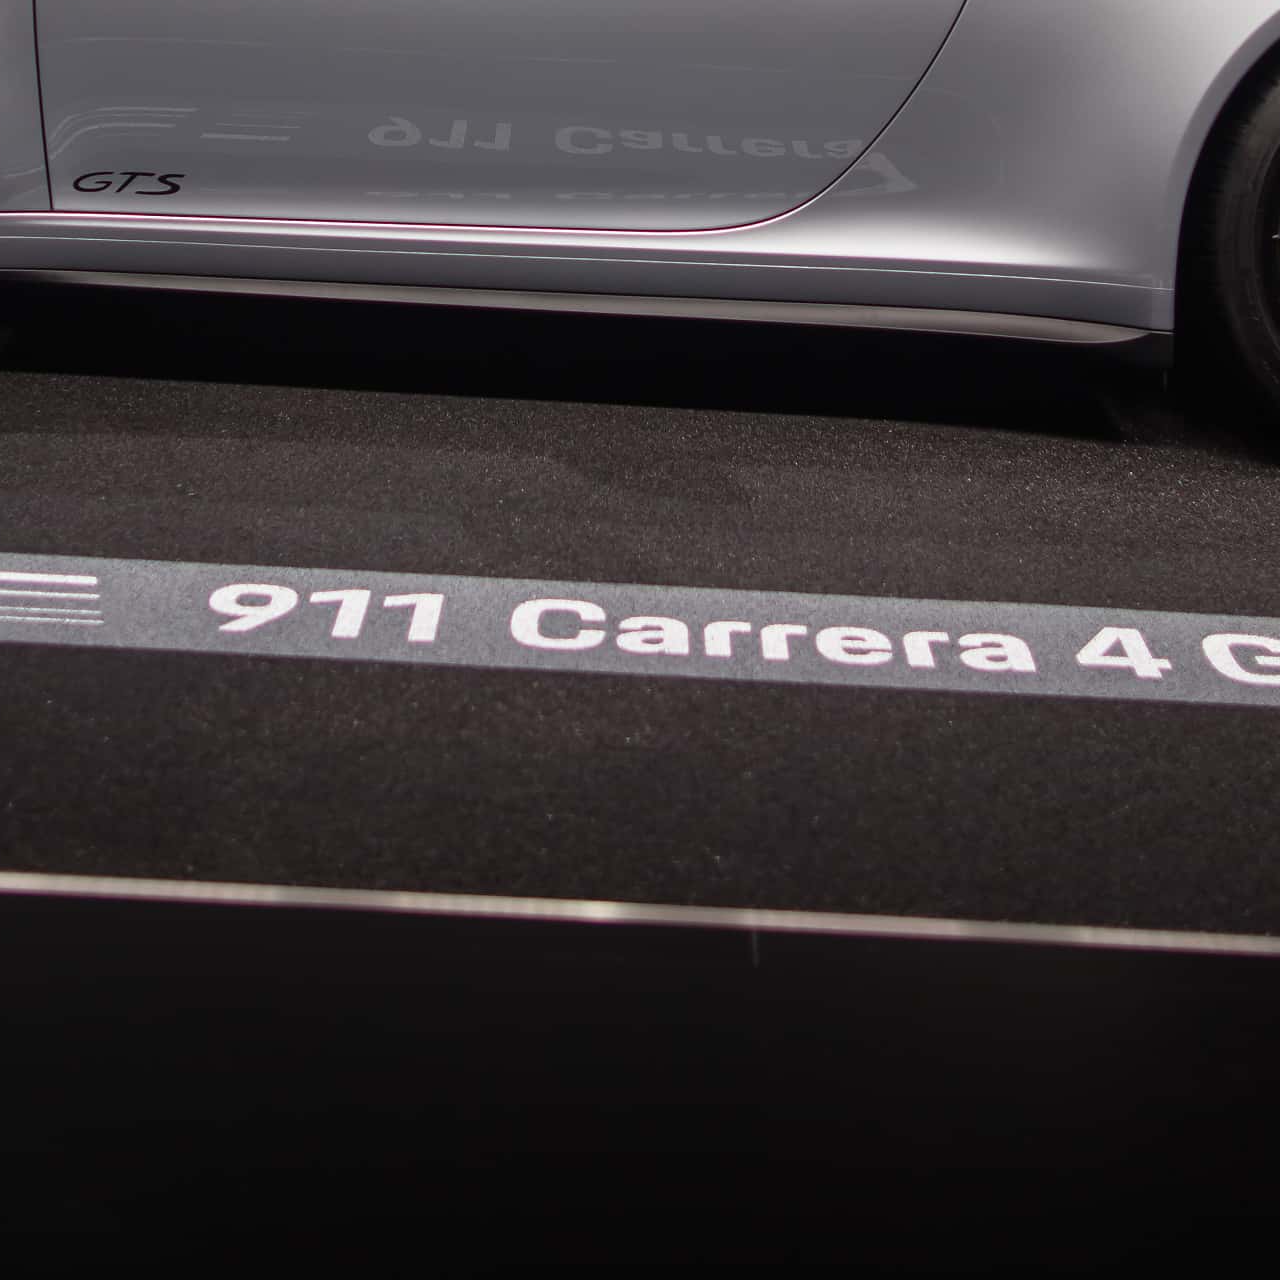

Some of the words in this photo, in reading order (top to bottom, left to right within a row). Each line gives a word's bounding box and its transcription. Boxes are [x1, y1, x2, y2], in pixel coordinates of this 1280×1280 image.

[73, 171, 185, 195] GTS
[209, 582, 446, 642] 911
[509, 598, 1037, 673] Carrera
[1076, 626, 1172, 679] 4
